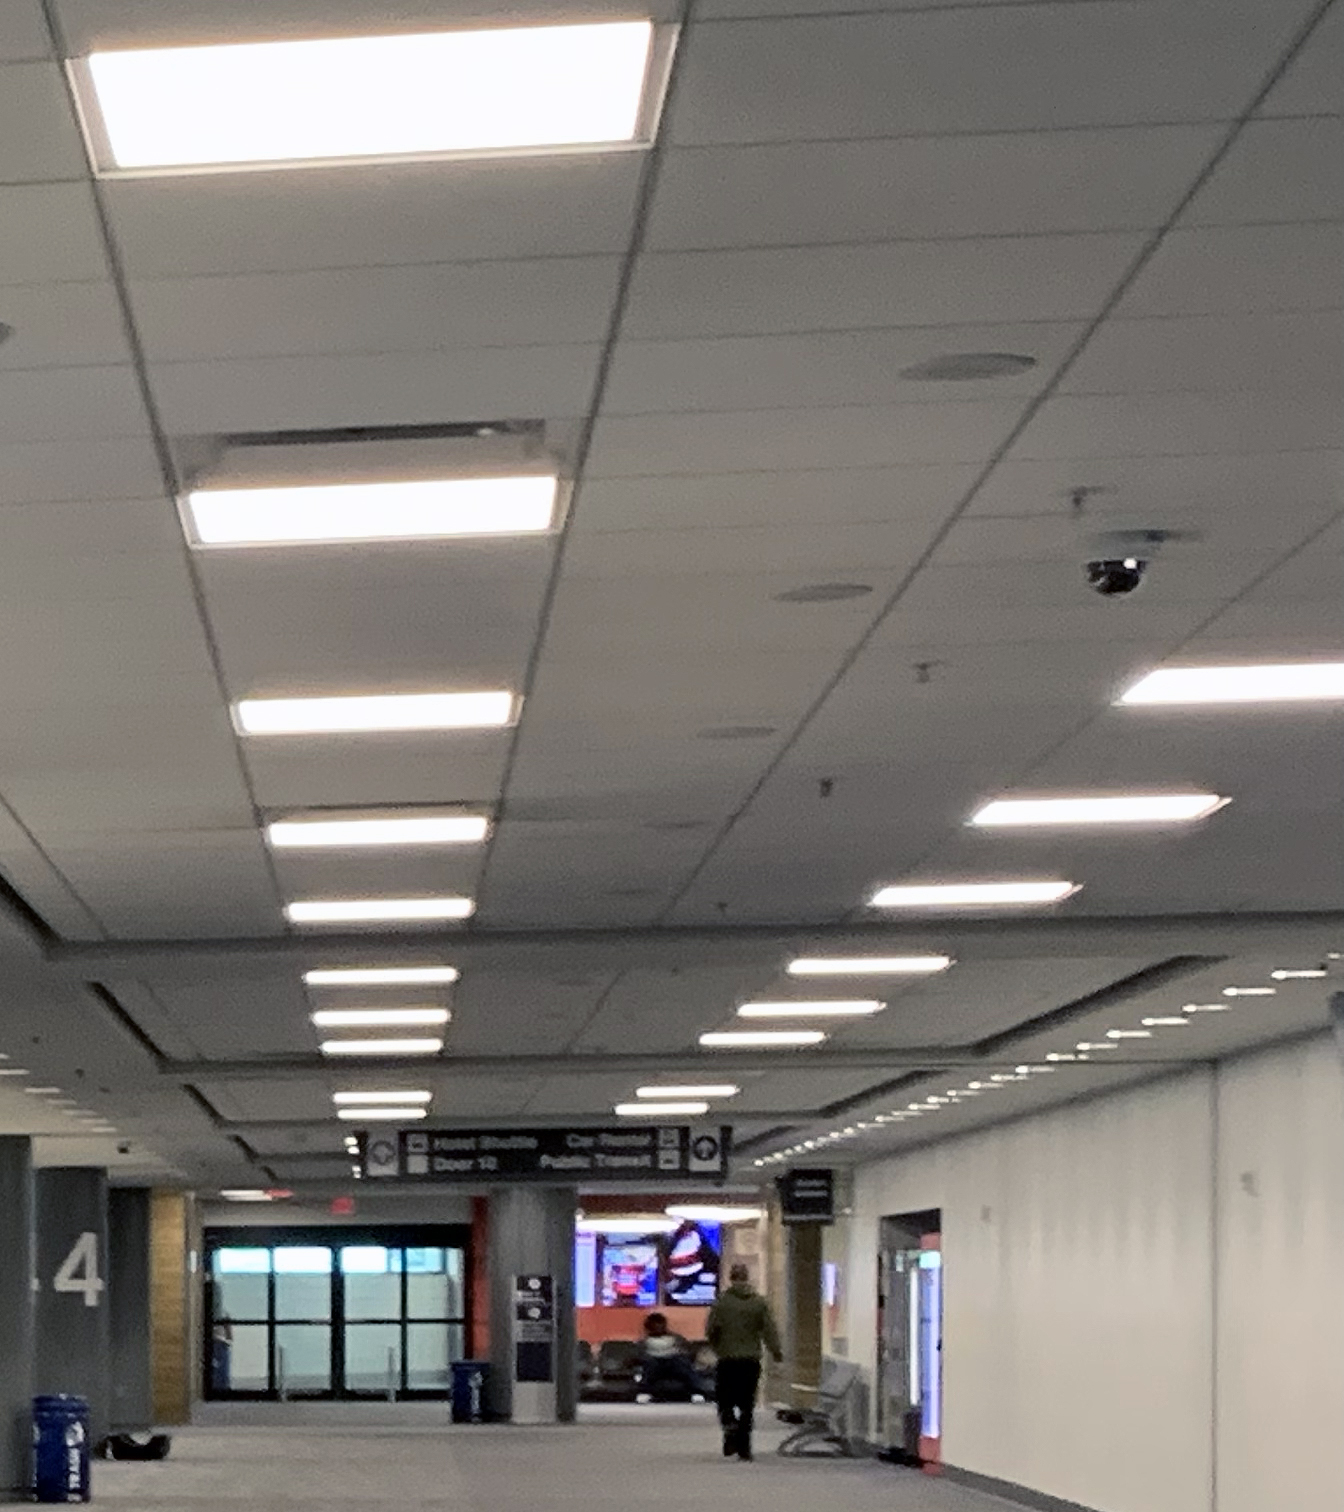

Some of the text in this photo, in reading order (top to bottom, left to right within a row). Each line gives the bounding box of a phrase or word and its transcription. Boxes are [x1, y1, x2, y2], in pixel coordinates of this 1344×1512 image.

[566, 1133, 594, 1148] Car
[540, 1154, 652, 1170] Public Transit
[54, 1231, 105, 1307] 4
